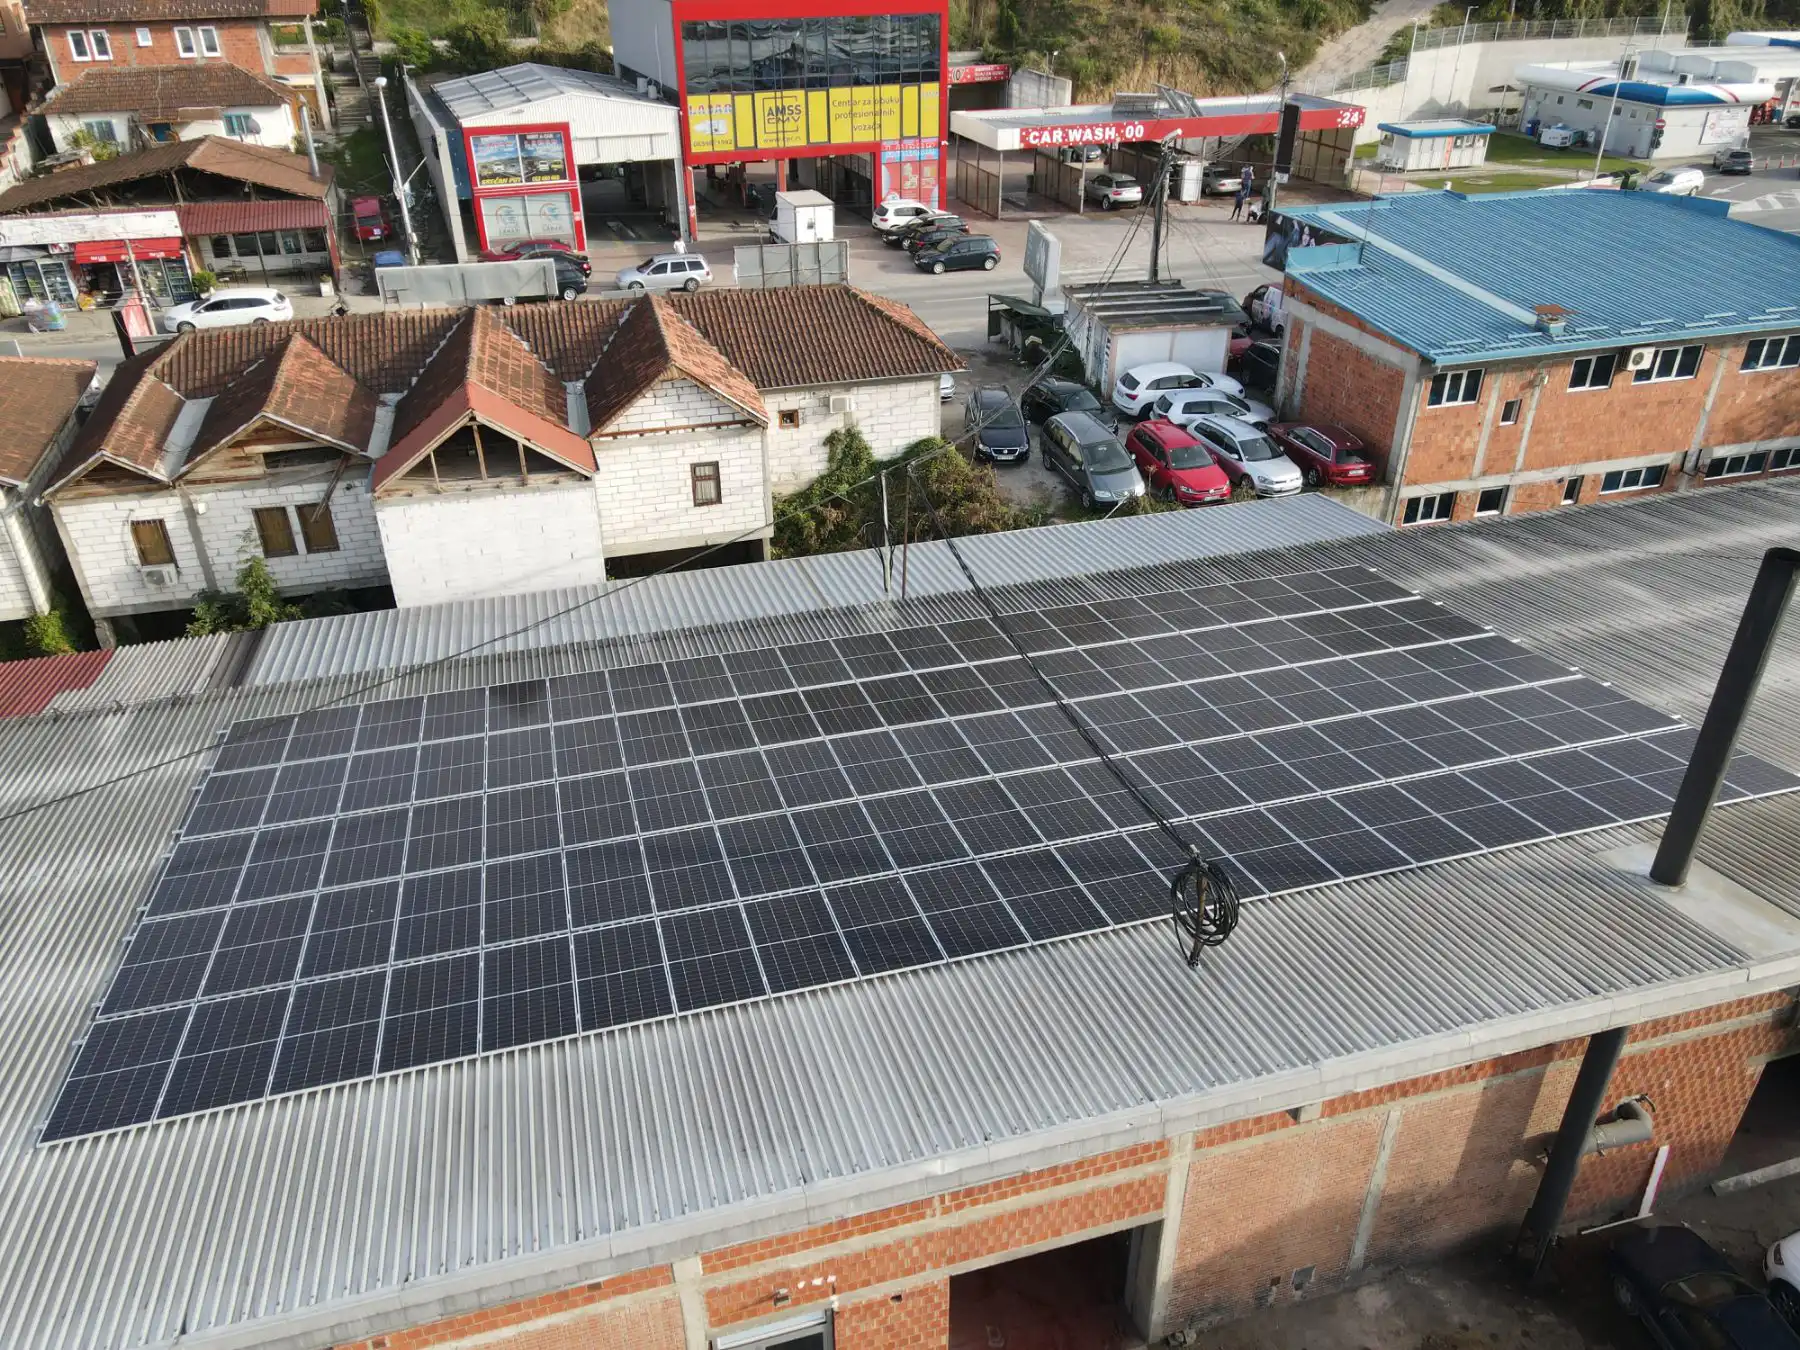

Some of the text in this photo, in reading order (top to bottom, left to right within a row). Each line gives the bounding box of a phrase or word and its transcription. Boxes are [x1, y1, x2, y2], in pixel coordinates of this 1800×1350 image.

[863, 98, 871, 106] za
[767, 104, 802, 116] AMSS
[1341, 111, 1360, 125] 24
[1029, 124, 1145, 144] CAR WASH 00
